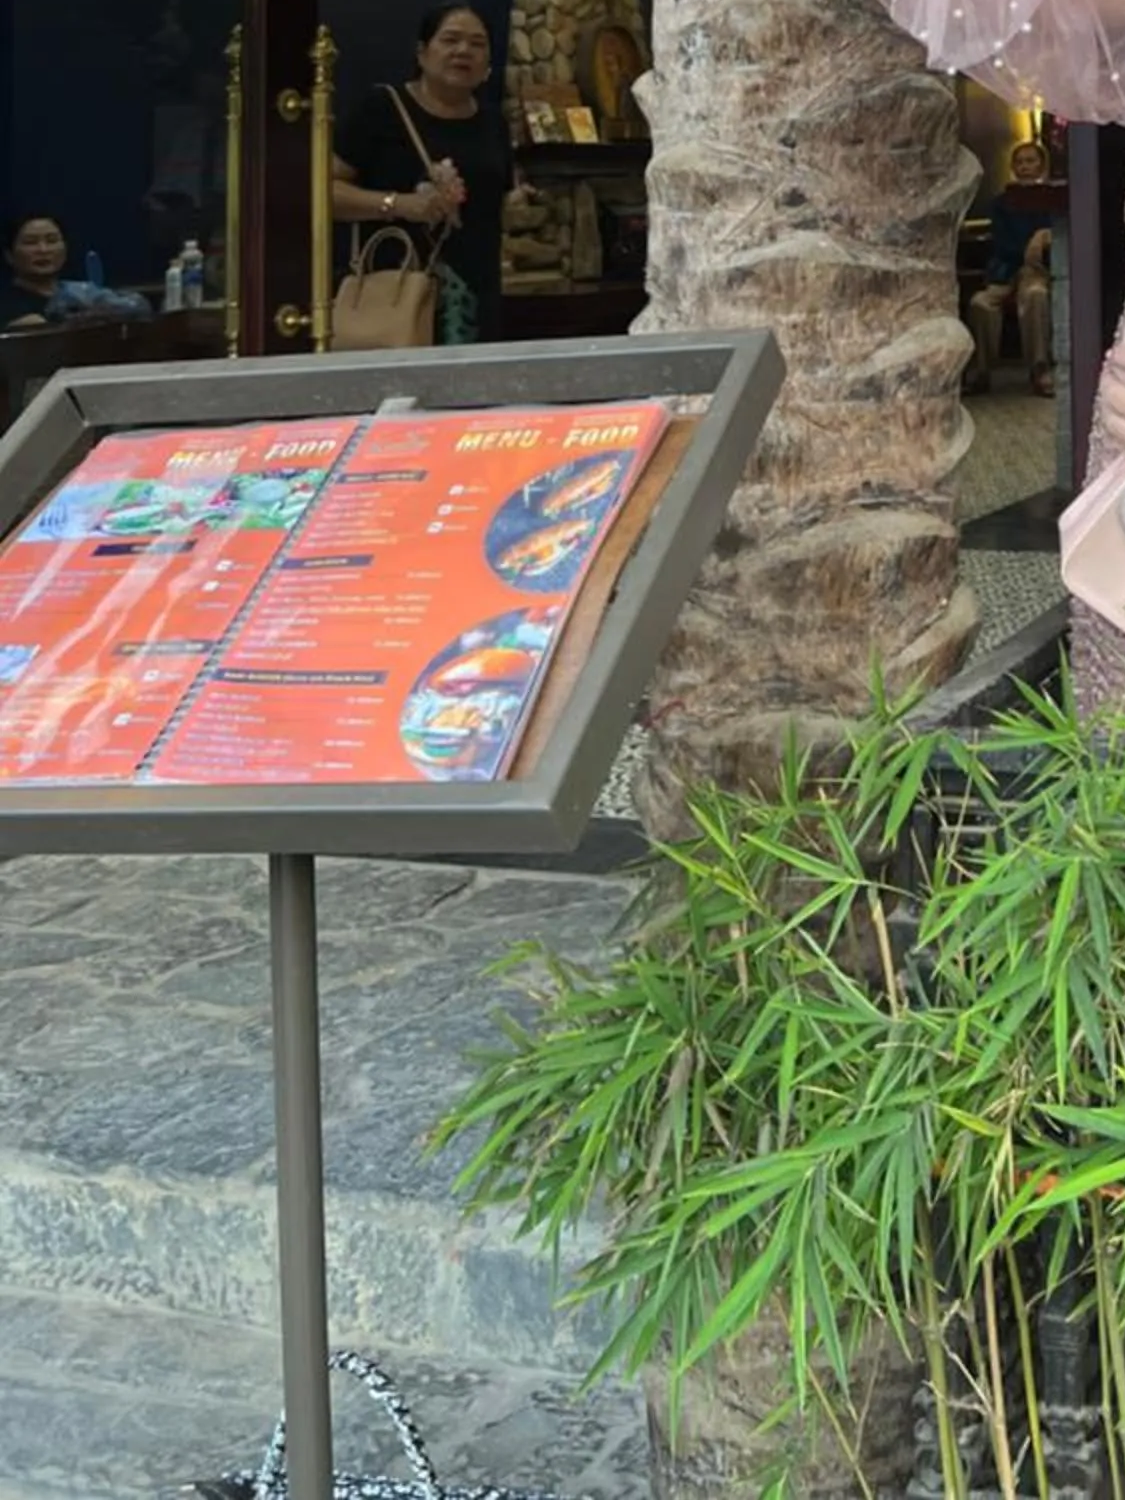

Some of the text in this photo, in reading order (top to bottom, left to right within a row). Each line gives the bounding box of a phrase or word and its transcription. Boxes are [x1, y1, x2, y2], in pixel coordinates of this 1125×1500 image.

[264, 439, 337, 461] FOOD
[455, 429, 542, 452] MENU
[562, 424, 639, 449] FOOD
